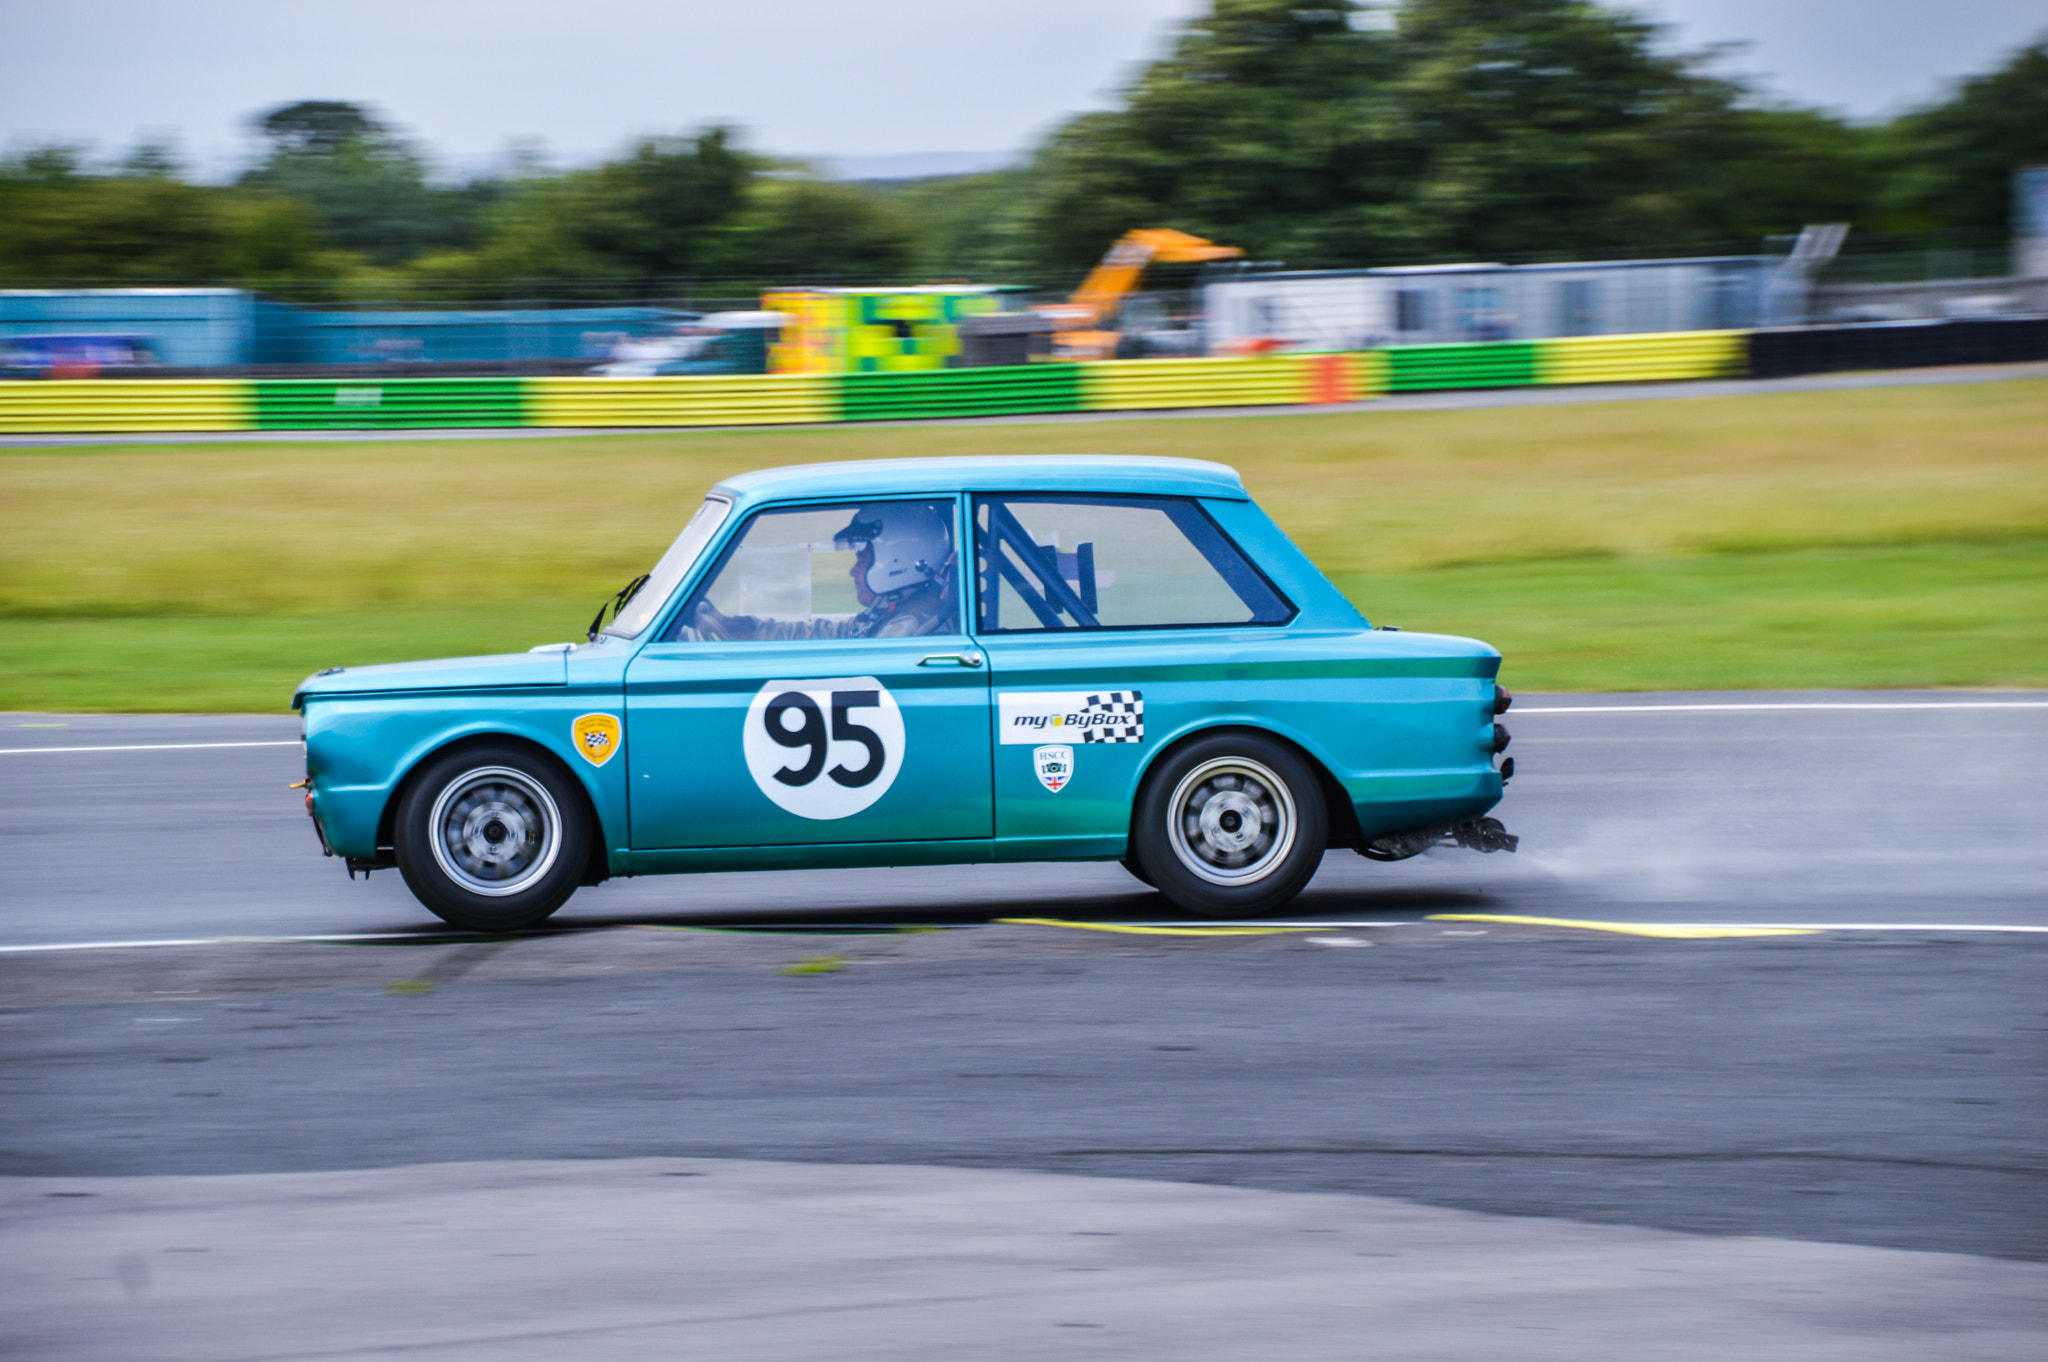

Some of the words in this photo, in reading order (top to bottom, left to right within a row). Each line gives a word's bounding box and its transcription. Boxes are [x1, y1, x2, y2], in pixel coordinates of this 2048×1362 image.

[1013, 715, 1048, 730] my
[1063, 713, 1131, 729] ByBox
[763, 690, 886, 788] 95
[1039, 750, 1069, 760] HSCC
